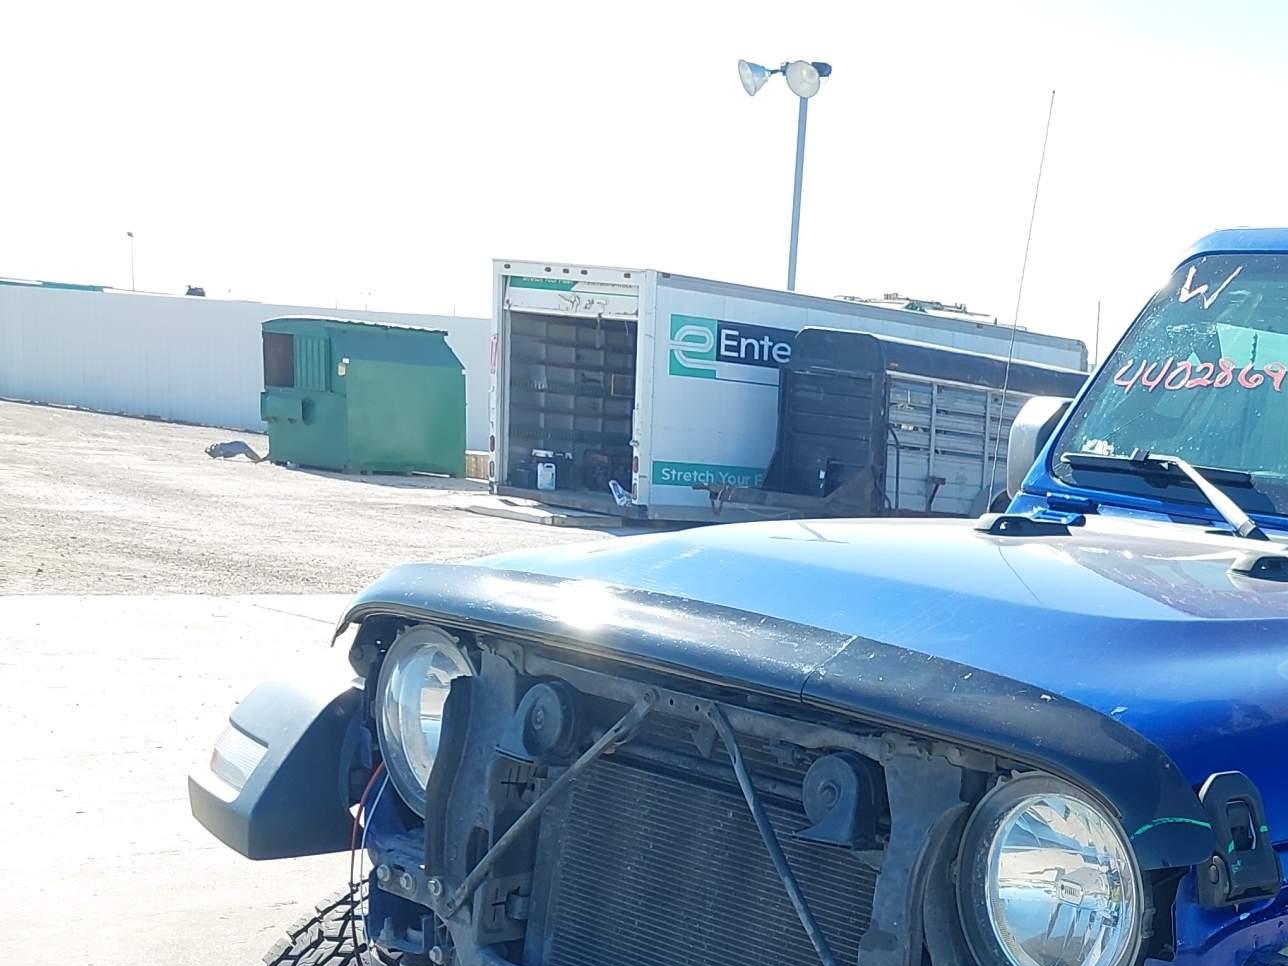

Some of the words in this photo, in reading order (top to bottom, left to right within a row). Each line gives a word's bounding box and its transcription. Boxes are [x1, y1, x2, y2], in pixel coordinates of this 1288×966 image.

[720, 328, 792, 364] Ente
[661, 467, 715, 484] Stretch
[718, 471, 751, 485] Your
